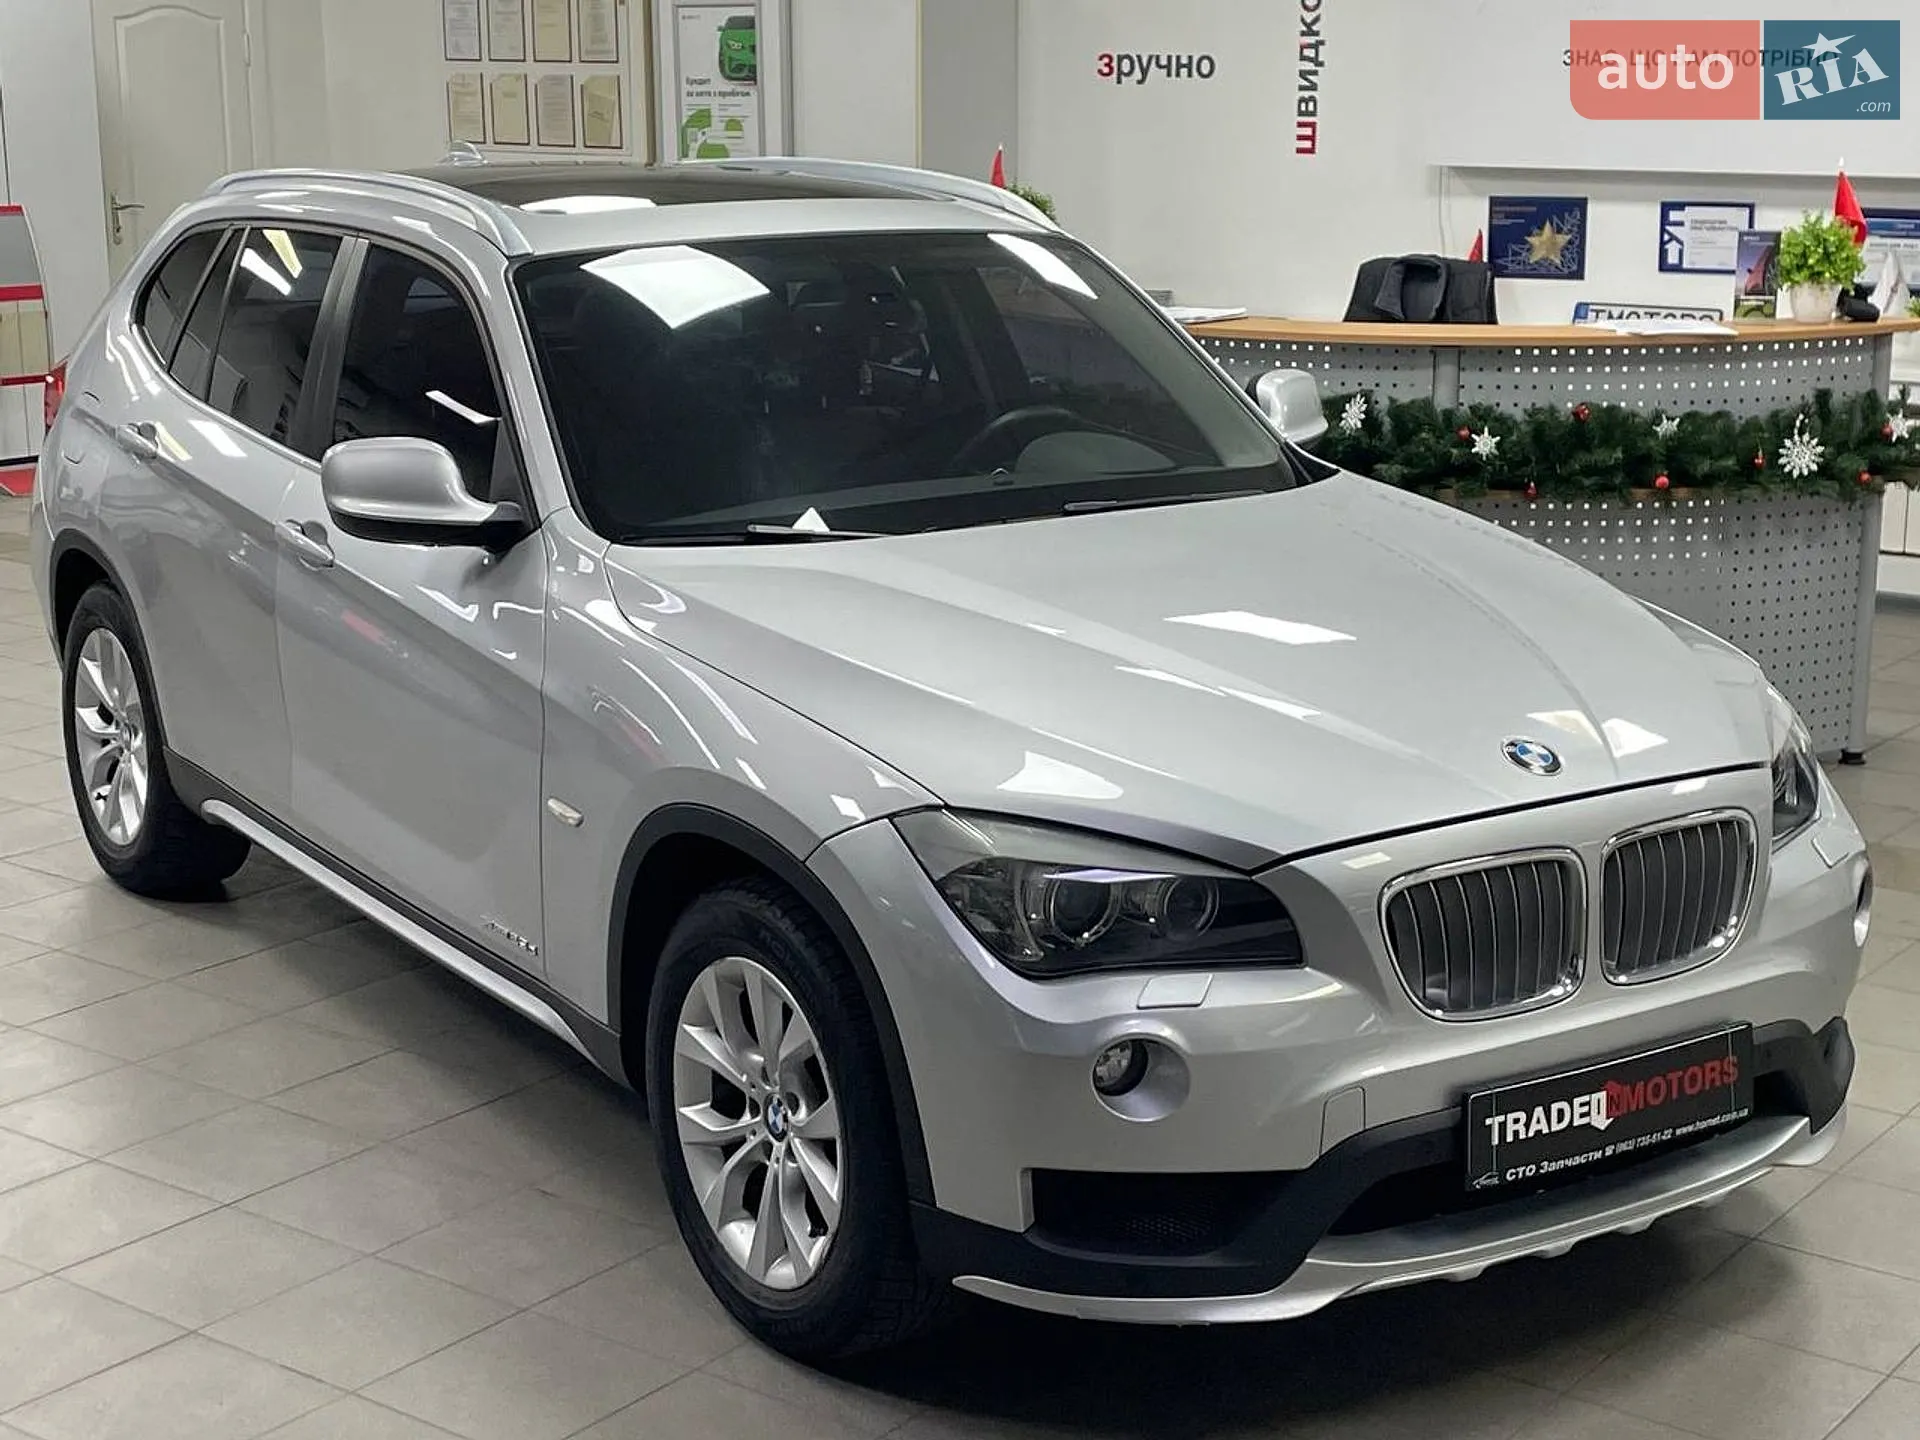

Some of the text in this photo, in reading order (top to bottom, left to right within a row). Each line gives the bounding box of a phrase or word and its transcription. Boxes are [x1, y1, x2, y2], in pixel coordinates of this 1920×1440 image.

[1097, 52, 1217, 85] зручно
[1726, 49, 1839, 67] ПОТРІБНО
[1296, 0, 1325, 155] швидко
[1484, 1095, 1591, 1146] TRADE
[1623, 1056, 1740, 1112] MOTORS
[1505, 1163, 1536, 1182] СТО
[1539, 1148, 1603, 1174] Запчасти
